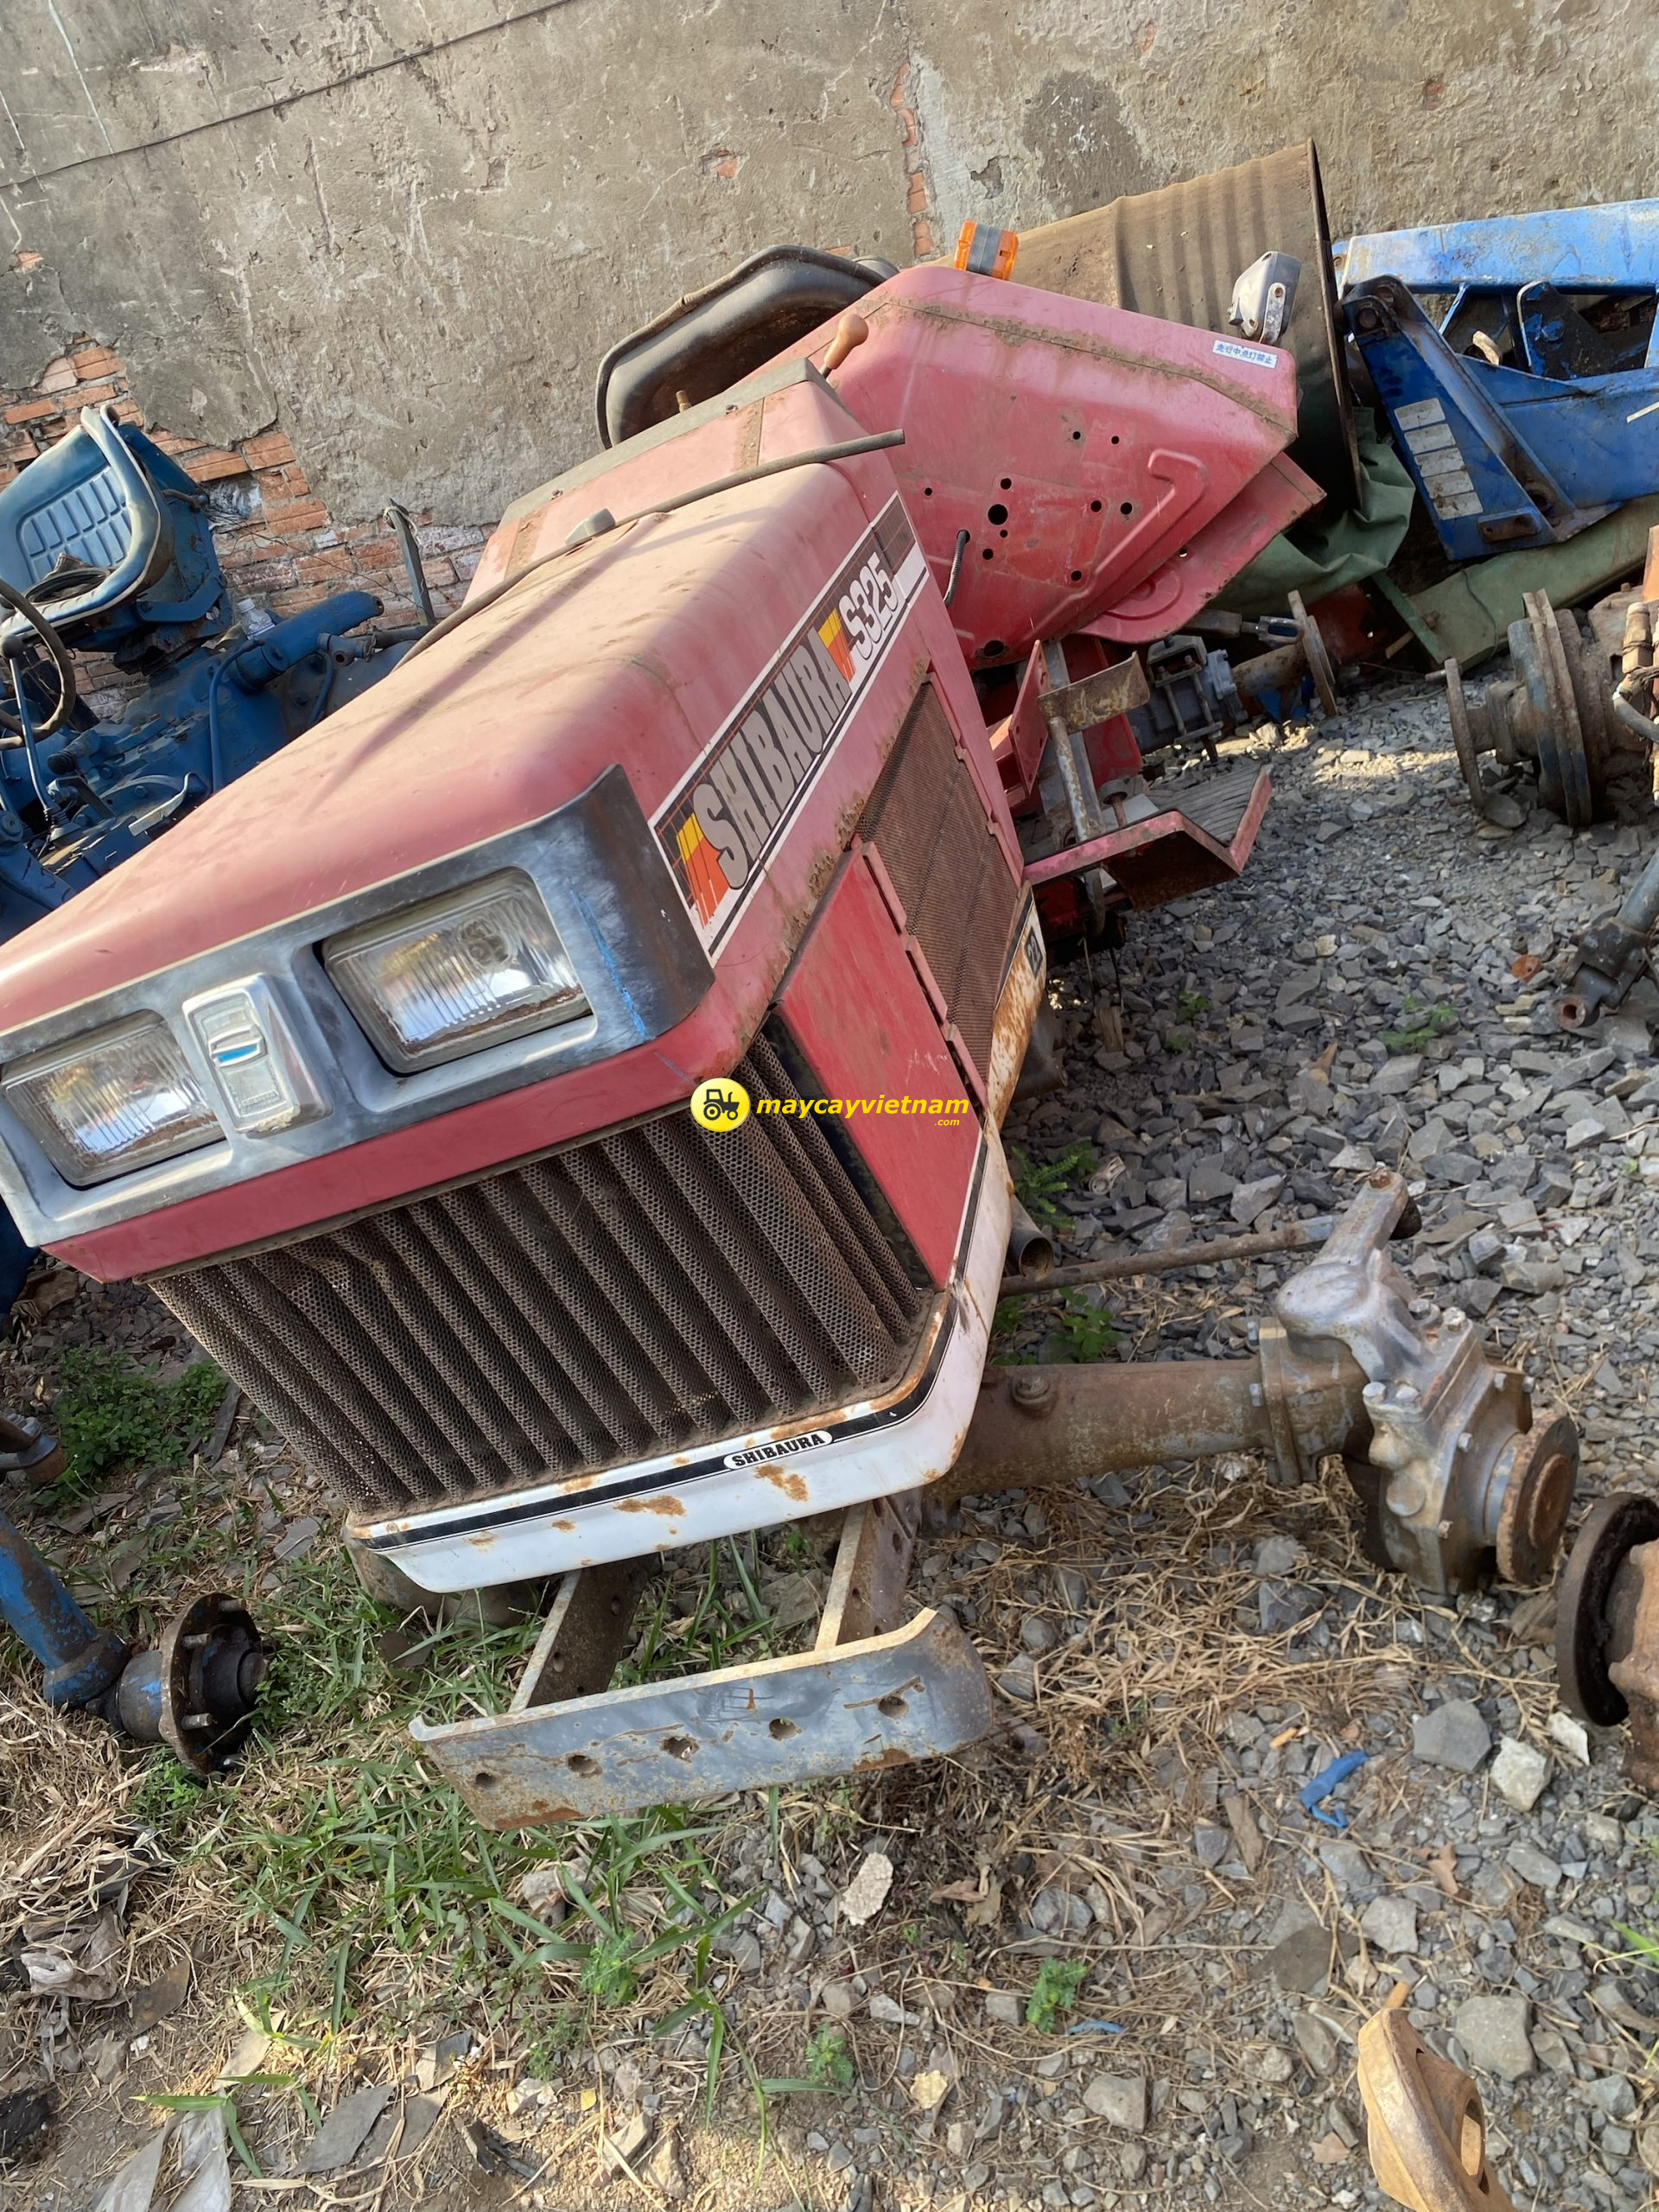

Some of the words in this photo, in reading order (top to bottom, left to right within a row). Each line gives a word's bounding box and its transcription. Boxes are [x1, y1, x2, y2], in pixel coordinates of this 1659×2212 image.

[692, 626, 852, 890] SHIBAURA
[838, 552, 898, 660] S325
[731, 1433, 826, 1466] SHIBAURA
